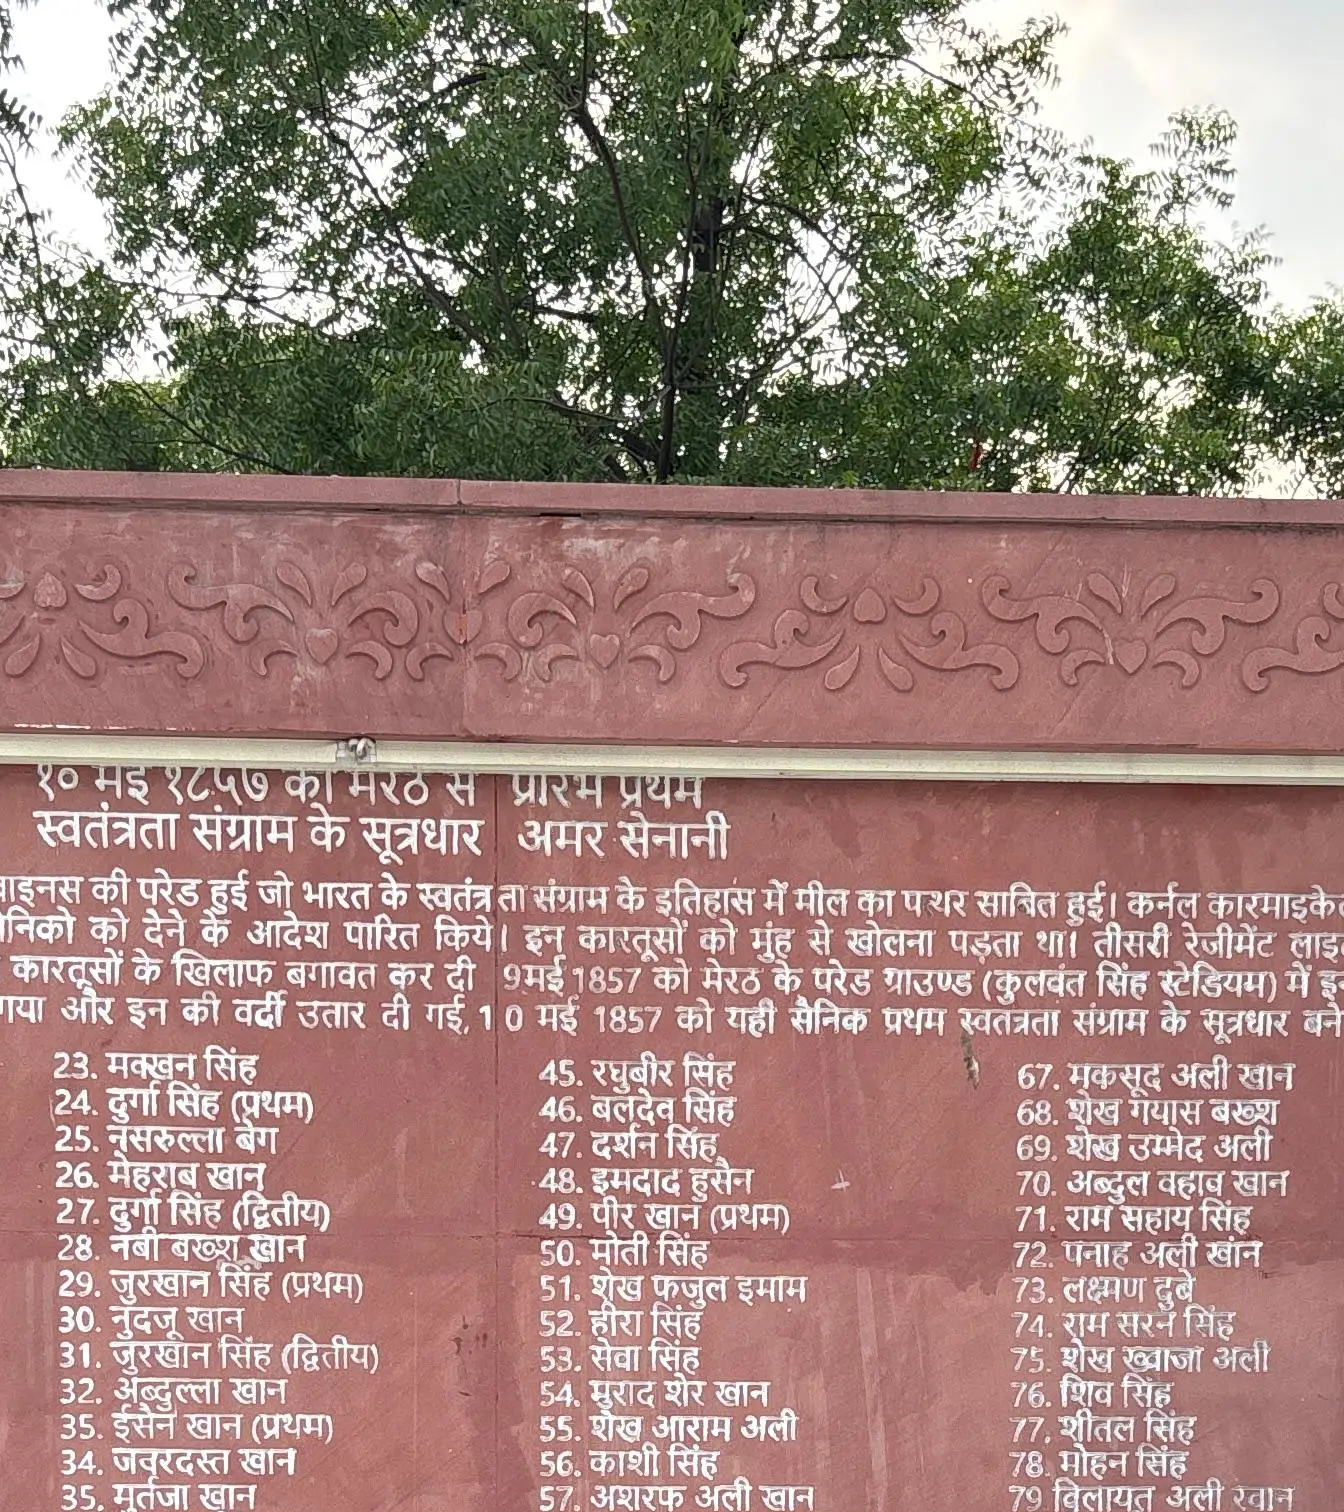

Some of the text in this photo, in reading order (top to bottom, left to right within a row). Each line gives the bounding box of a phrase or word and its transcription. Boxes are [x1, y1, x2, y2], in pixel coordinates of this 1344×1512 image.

[33, 802, 731, 865] स्वतंत्रता संग्राम के सूत्रधार अमर सेनानी
[88, 867, 131, 904] की
[136, 868, 203, 906] परेड
[207, 869, 249, 918] हुई
[256, 870, 294, 908] जो
[302, 882, 373, 910] भारत
[378, 872, 411, 910] के
[530, 878, 610, 914] संग्राम
[615, 876, 647, 914] के
[761, 879, 788, 915] में
[792, 880, 850, 916] मील
[855, 890, 896, 917] का
[1126, 882, 1201, 919] कर्नल
[88, 908, 130, 944] को
[142, 908, 187, 948] देने
[199, 904, 232, 947] के
[247, 910, 329, 950] आदेश
[343, 913, 420, 950] पारित
[523, 925, 565, 954] इन
[577, 917, 688, 962] कारतूसों
[699, 918, 738, 954] को
[807, 919, 833, 955] से
[845, 920, 936, 957] खोलना
[948, 930, 1023, 959] पड़ता
[1092, 922, 1169, 958] तीसरी
[1018, 1054, 1296, 1103] 67. मकसूद अली खान
[55, 1080, 313, 1124] 24. दुर्गा सिंह (प्रथम)
[539, 1087, 737, 1127] 46. बलदेव सिंह
[56, 1150, 267, 1194] 26. मेहराब खान
[540, 1230, 710, 1271] 50. मोती सिंह
[1011, 1303, 1236, 1343] 74. राम सरन सिंह
[61, 1450, 103, 1475] 34.
[237, 1448, 297, 1475] खान
[540, 1476, 814, 1512] 57. अशरफ अली खान
